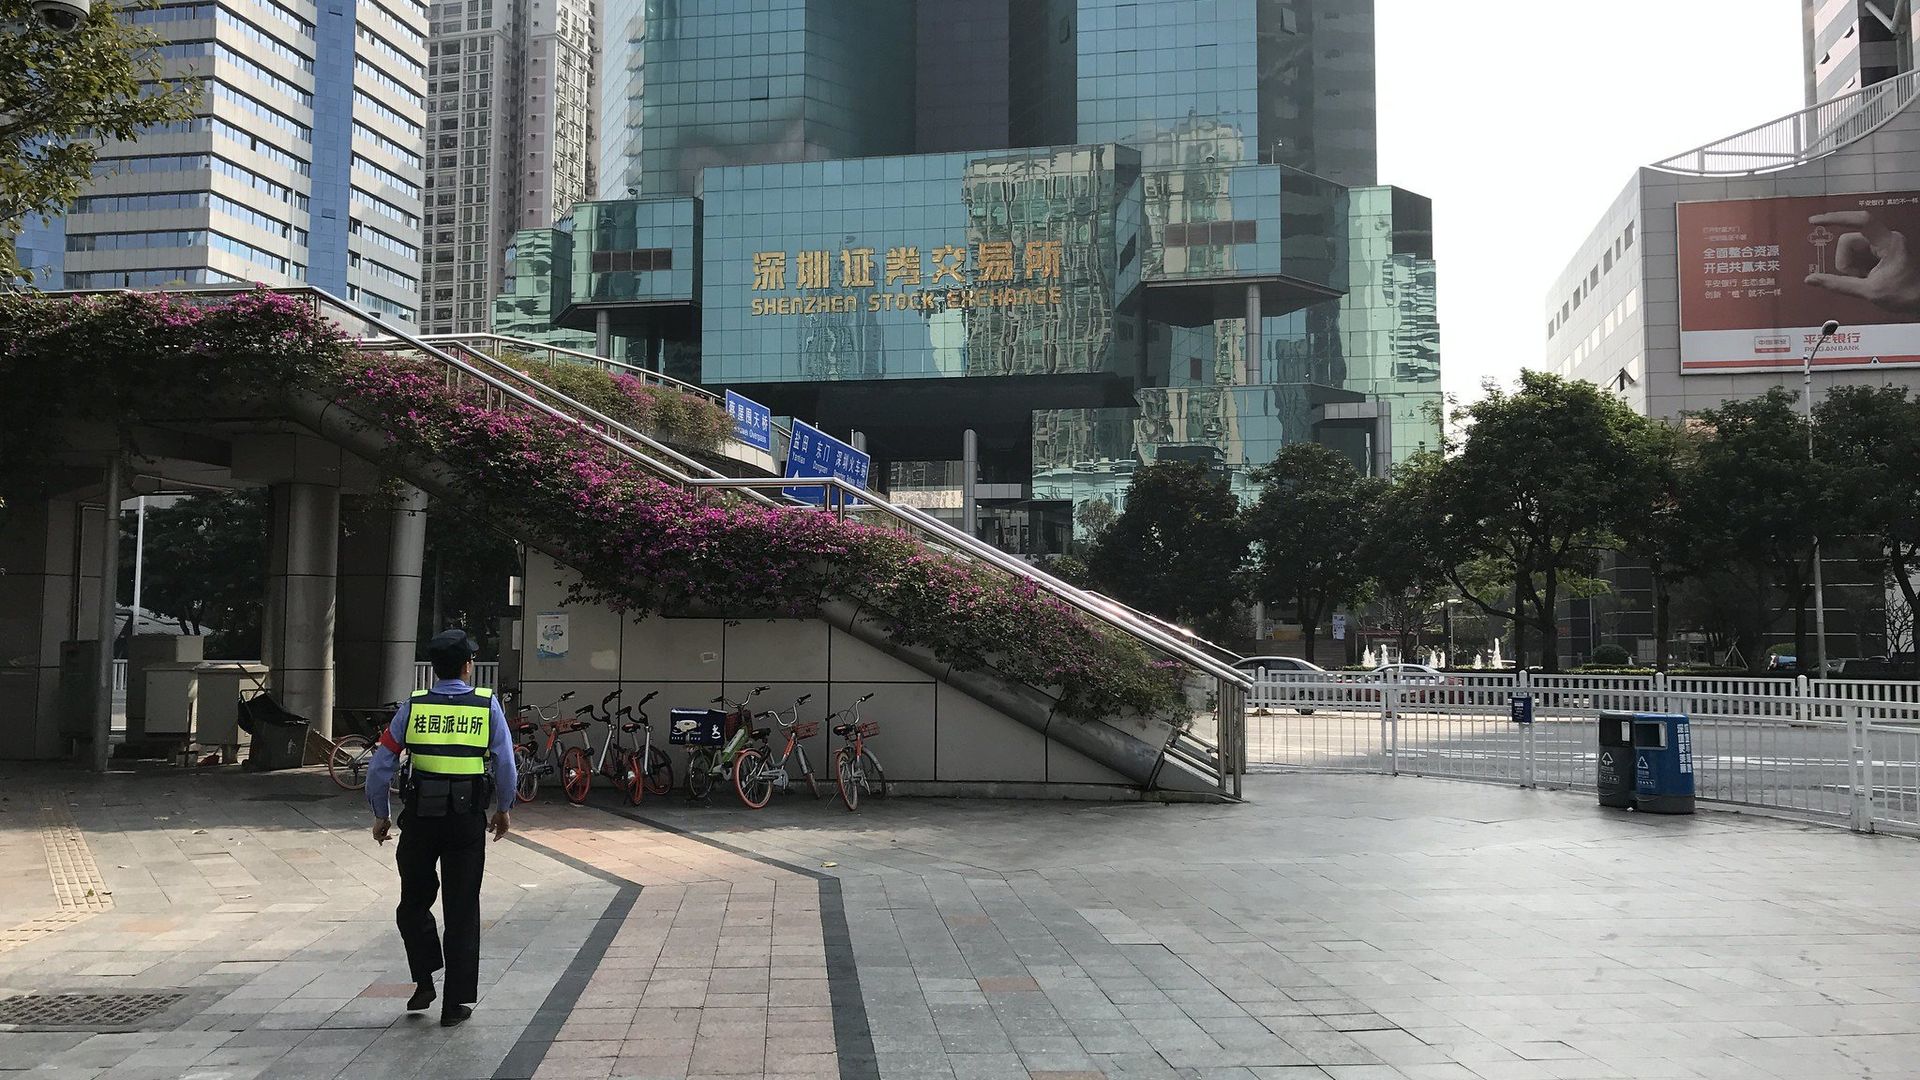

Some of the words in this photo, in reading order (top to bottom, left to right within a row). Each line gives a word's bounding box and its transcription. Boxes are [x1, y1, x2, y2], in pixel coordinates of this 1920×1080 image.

[1703, 245, 1780, 259] 全面整合资源
[751, 241, 1062, 291] 深圳证券交易所
[1703, 260, 1780, 274] 开启共赢未来
[751, 294, 857, 316] SHENZHEN
[868, 292, 935, 312] STOCK
[946, 286, 1062, 309] EXCHANGE
[816, 440, 830, 463] 东门
[413, 714, 484, 736] 桂园派出所
